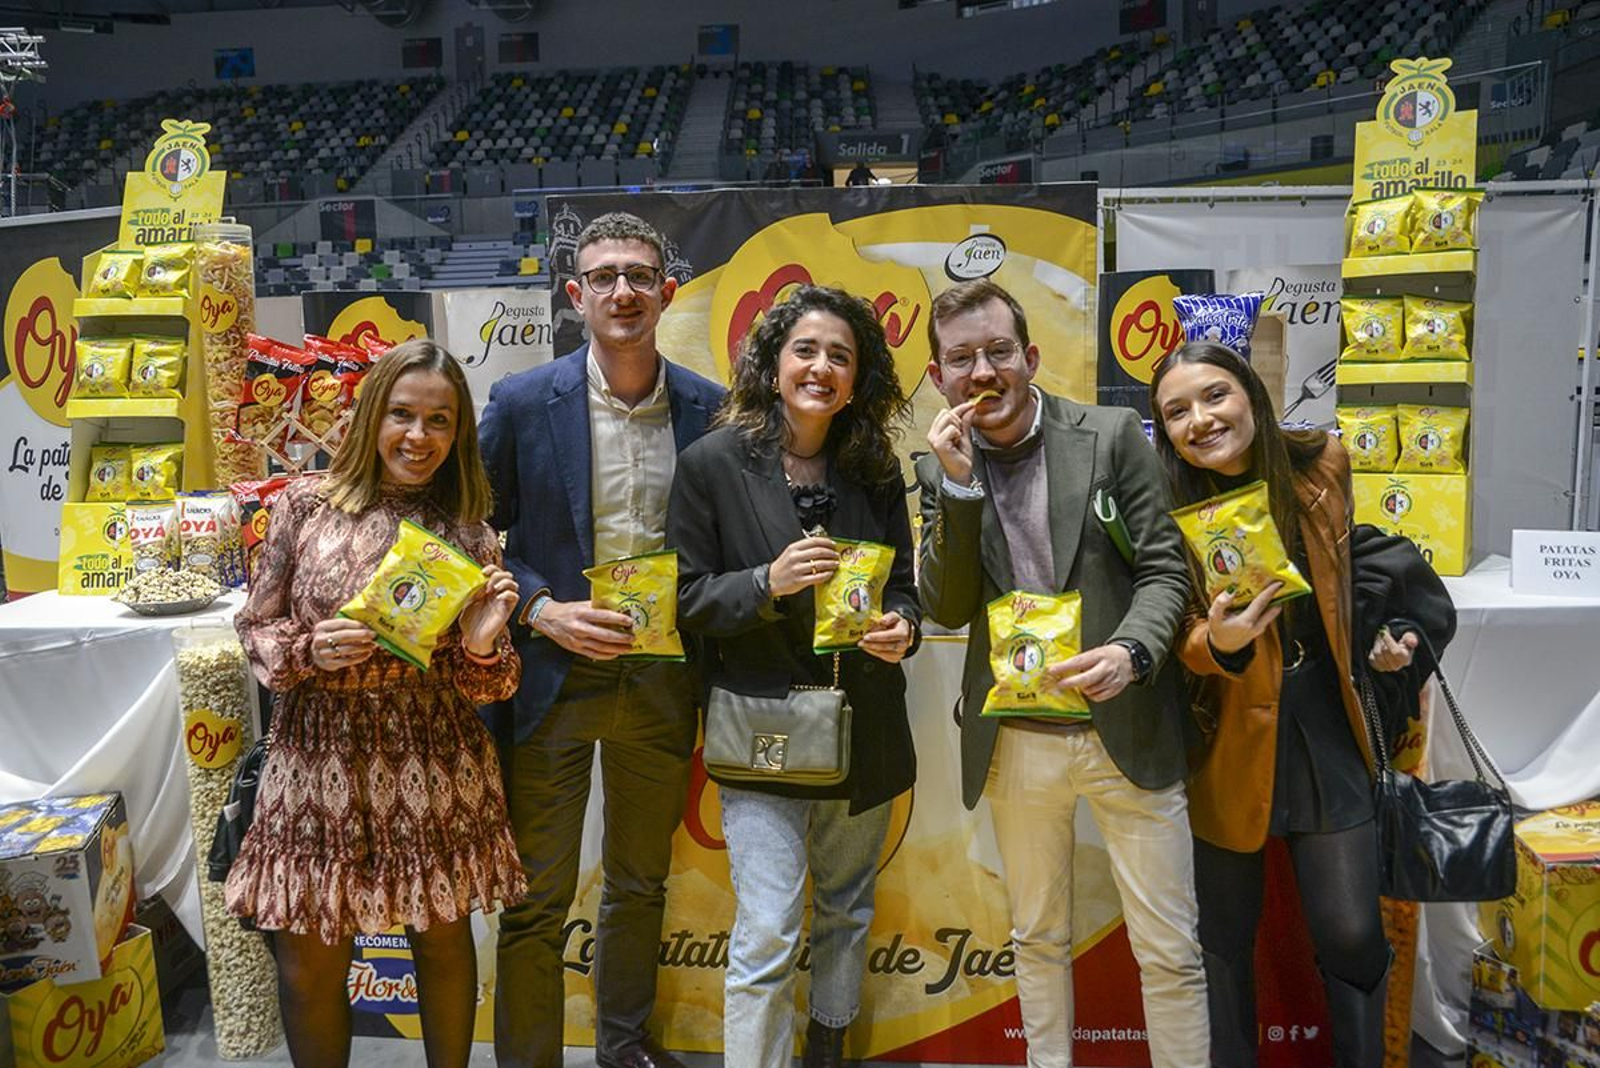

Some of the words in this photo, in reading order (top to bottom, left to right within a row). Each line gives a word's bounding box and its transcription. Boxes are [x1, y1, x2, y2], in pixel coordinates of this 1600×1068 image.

[1399, 82, 1437, 95] JAEN
[166, 141, 200, 151] JAEN
[837, 142, 887, 157] Salida
[900, 134, 910, 155] 1
[977, 163, 1014, 179] Sector
[1373, 160, 1411, 178] todo
[1415, 157, 1429, 175] al
[1371, 170, 1467, 200] amarillo
[138, 211, 169, 226] todo
[173, 208, 186, 224] al
[319, 202, 355, 213] Sector
[1268, 277, 1337, 297] Degusta
[200, 292, 235, 328] Oya
[489, 301, 545, 320] Degusta
[473, 318, 552, 369] Jaén
[254, 380, 284, 402] Oya
[310, 375, 338, 397] Oya
[8, 436, 36, 474] La
[40, 474, 65, 502] de
[130, 525, 166, 541] OYA
[180, 519, 217, 534] OYA
[1540, 544, 1597, 555] PATATAS
[111, 554, 122, 569] al
[1544, 557, 1592, 567] FRITAS
[1553, 570, 1581, 580] OYA
[186, 721, 239, 762] Oya
[1393, 732, 1423, 758] ya
[55, 855, 80, 875] 25
[353, 935, 411, 949] ECOMEN
[561, 918, 596, 976] La
[868, 933, 926, 974] de
[925, 927, 1016, 995] Jaé
[348, 960, 401, 1005] Flor
[42, 980, 135, 1064] Oya
